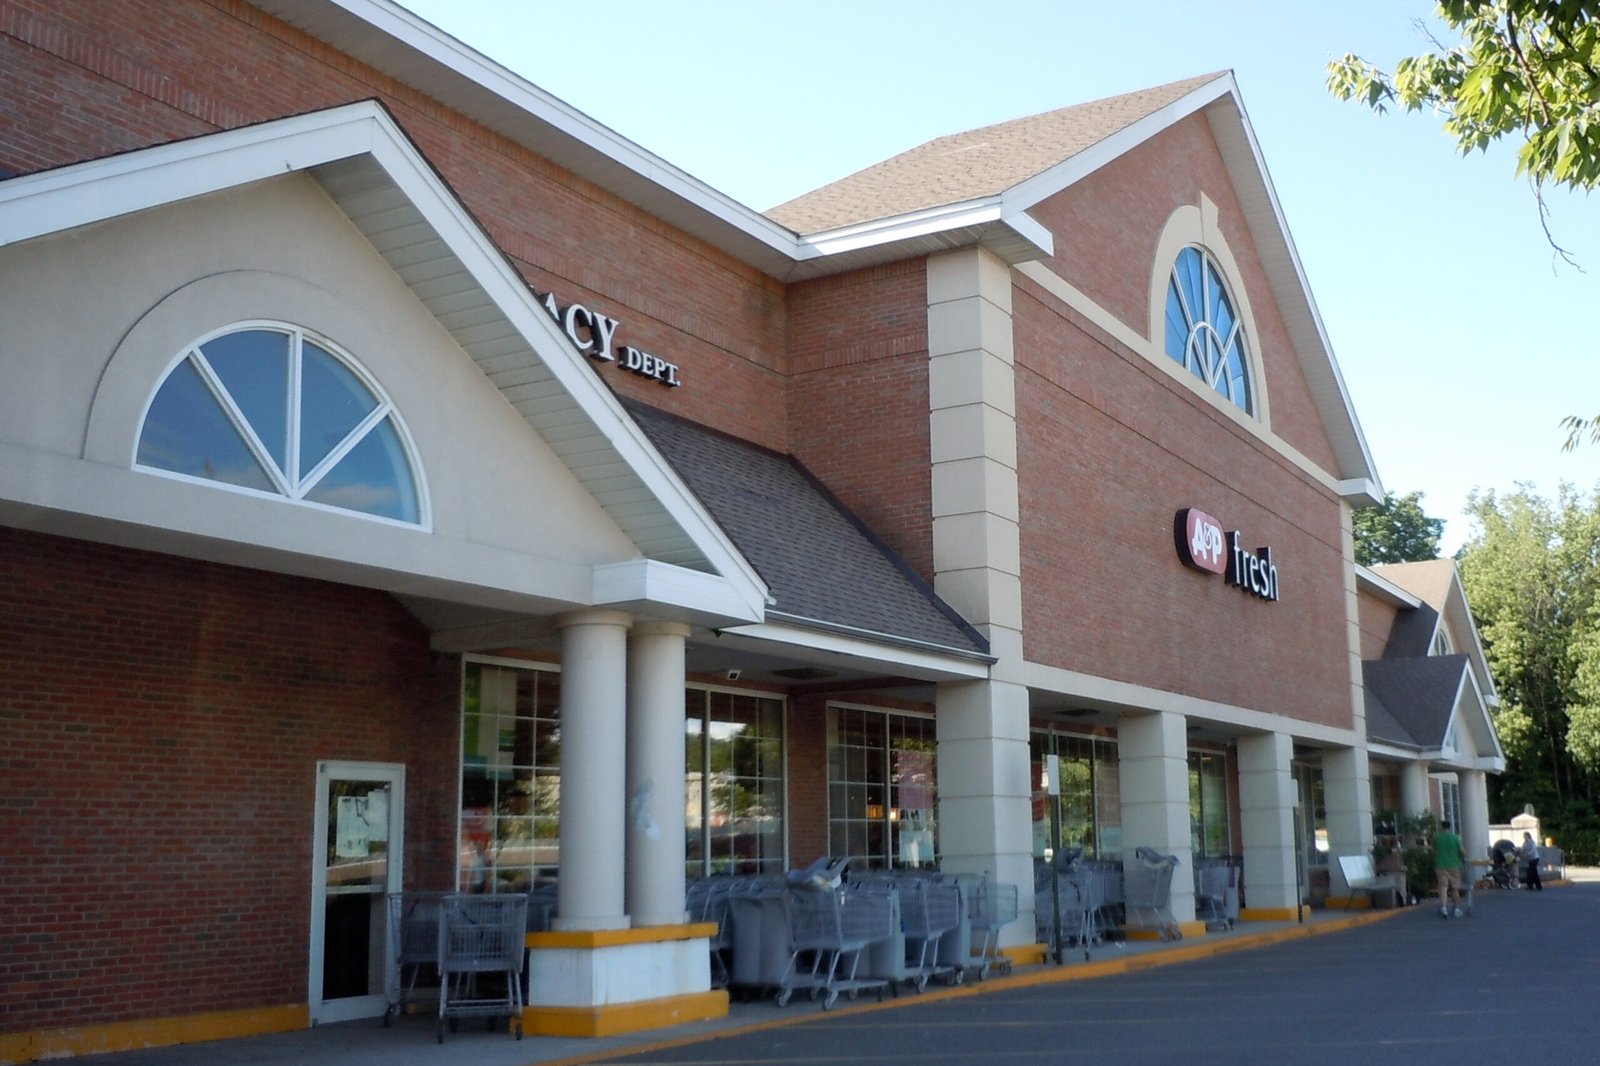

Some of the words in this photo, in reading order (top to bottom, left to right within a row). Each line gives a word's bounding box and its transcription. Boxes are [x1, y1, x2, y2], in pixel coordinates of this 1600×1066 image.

[627, 346, 682, 386] DEPT.
[1192, 518, 1222, 565] A&P
[1234, 530, 1279, 601] fresh
